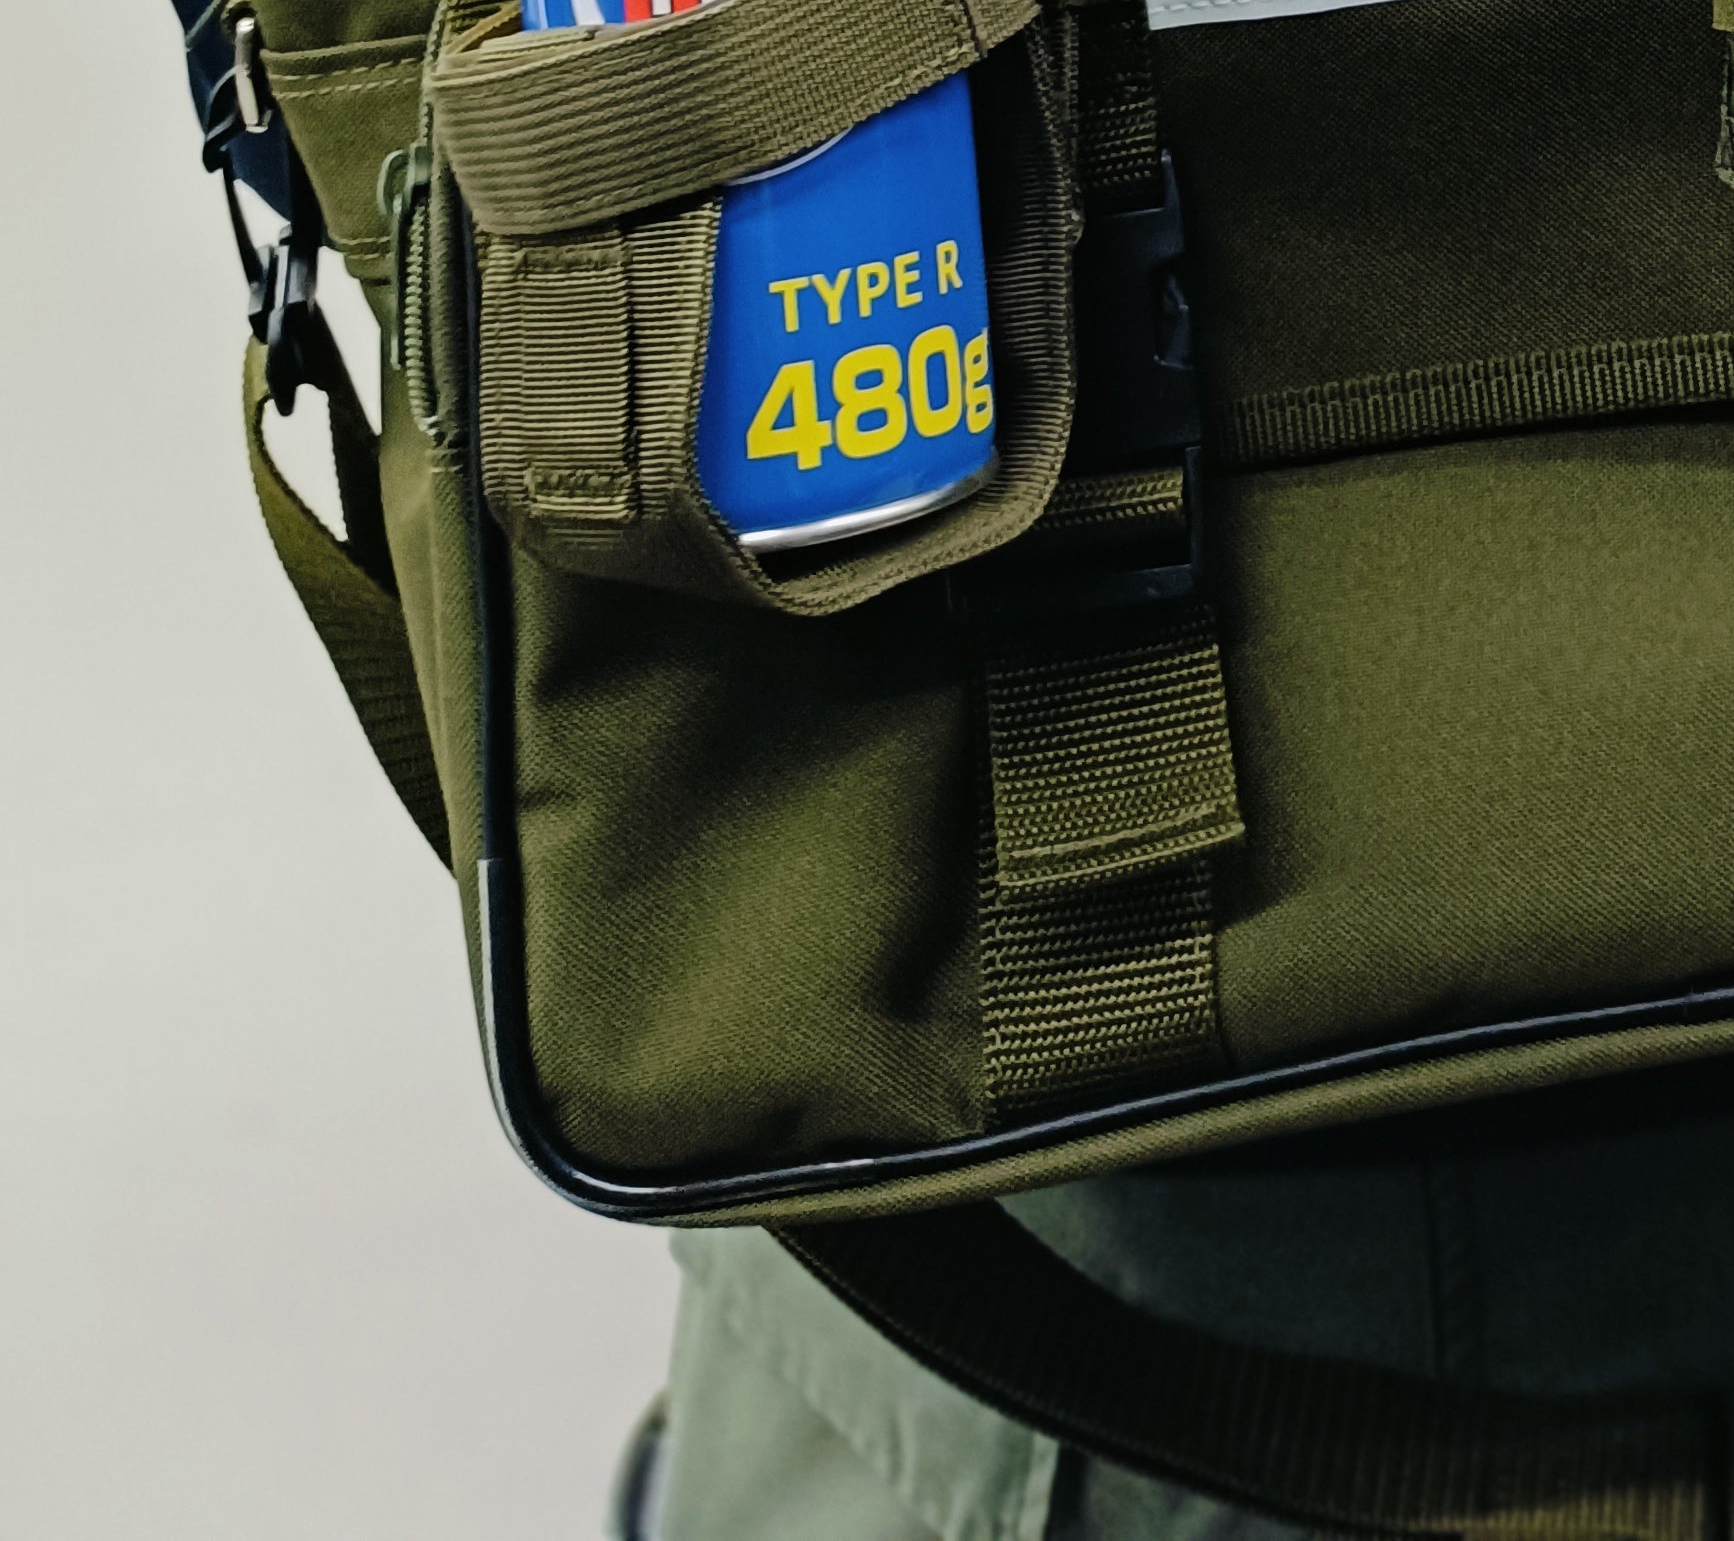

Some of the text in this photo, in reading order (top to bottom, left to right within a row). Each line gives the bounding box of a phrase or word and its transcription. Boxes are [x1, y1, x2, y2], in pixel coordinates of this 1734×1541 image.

[768, 239, 963, 333] TYPE R
[746, 324, 994, 471] 480g
